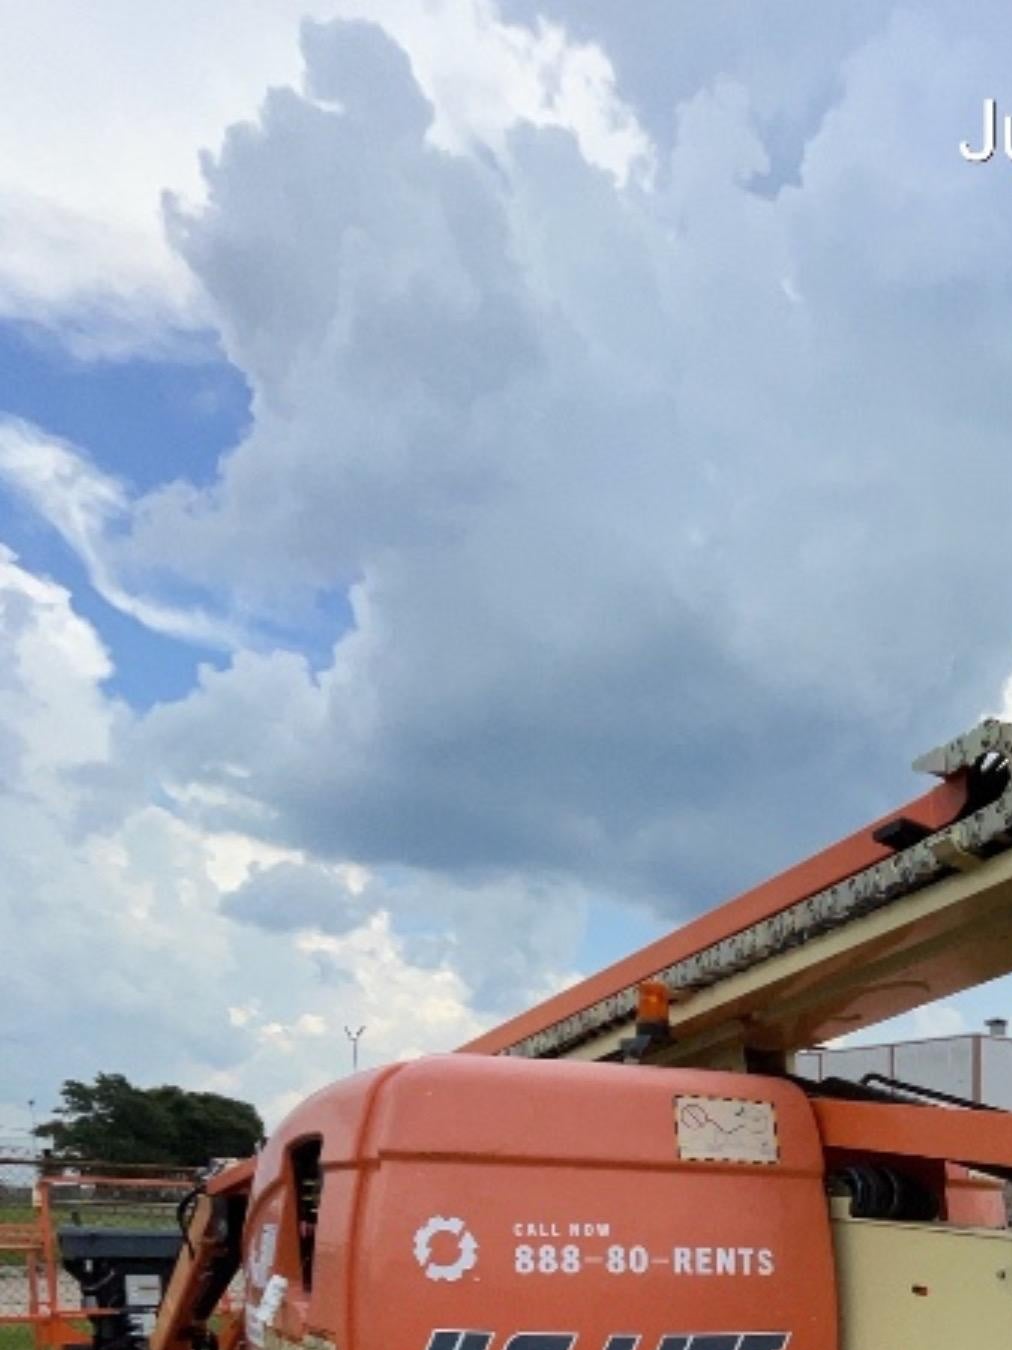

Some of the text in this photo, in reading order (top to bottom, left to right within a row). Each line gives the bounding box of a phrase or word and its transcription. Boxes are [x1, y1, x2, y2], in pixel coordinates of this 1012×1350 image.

[513, 1222, 611, 1237] CALL NOW
[513, 1244, 775, 1276] 888-80-RENTS
